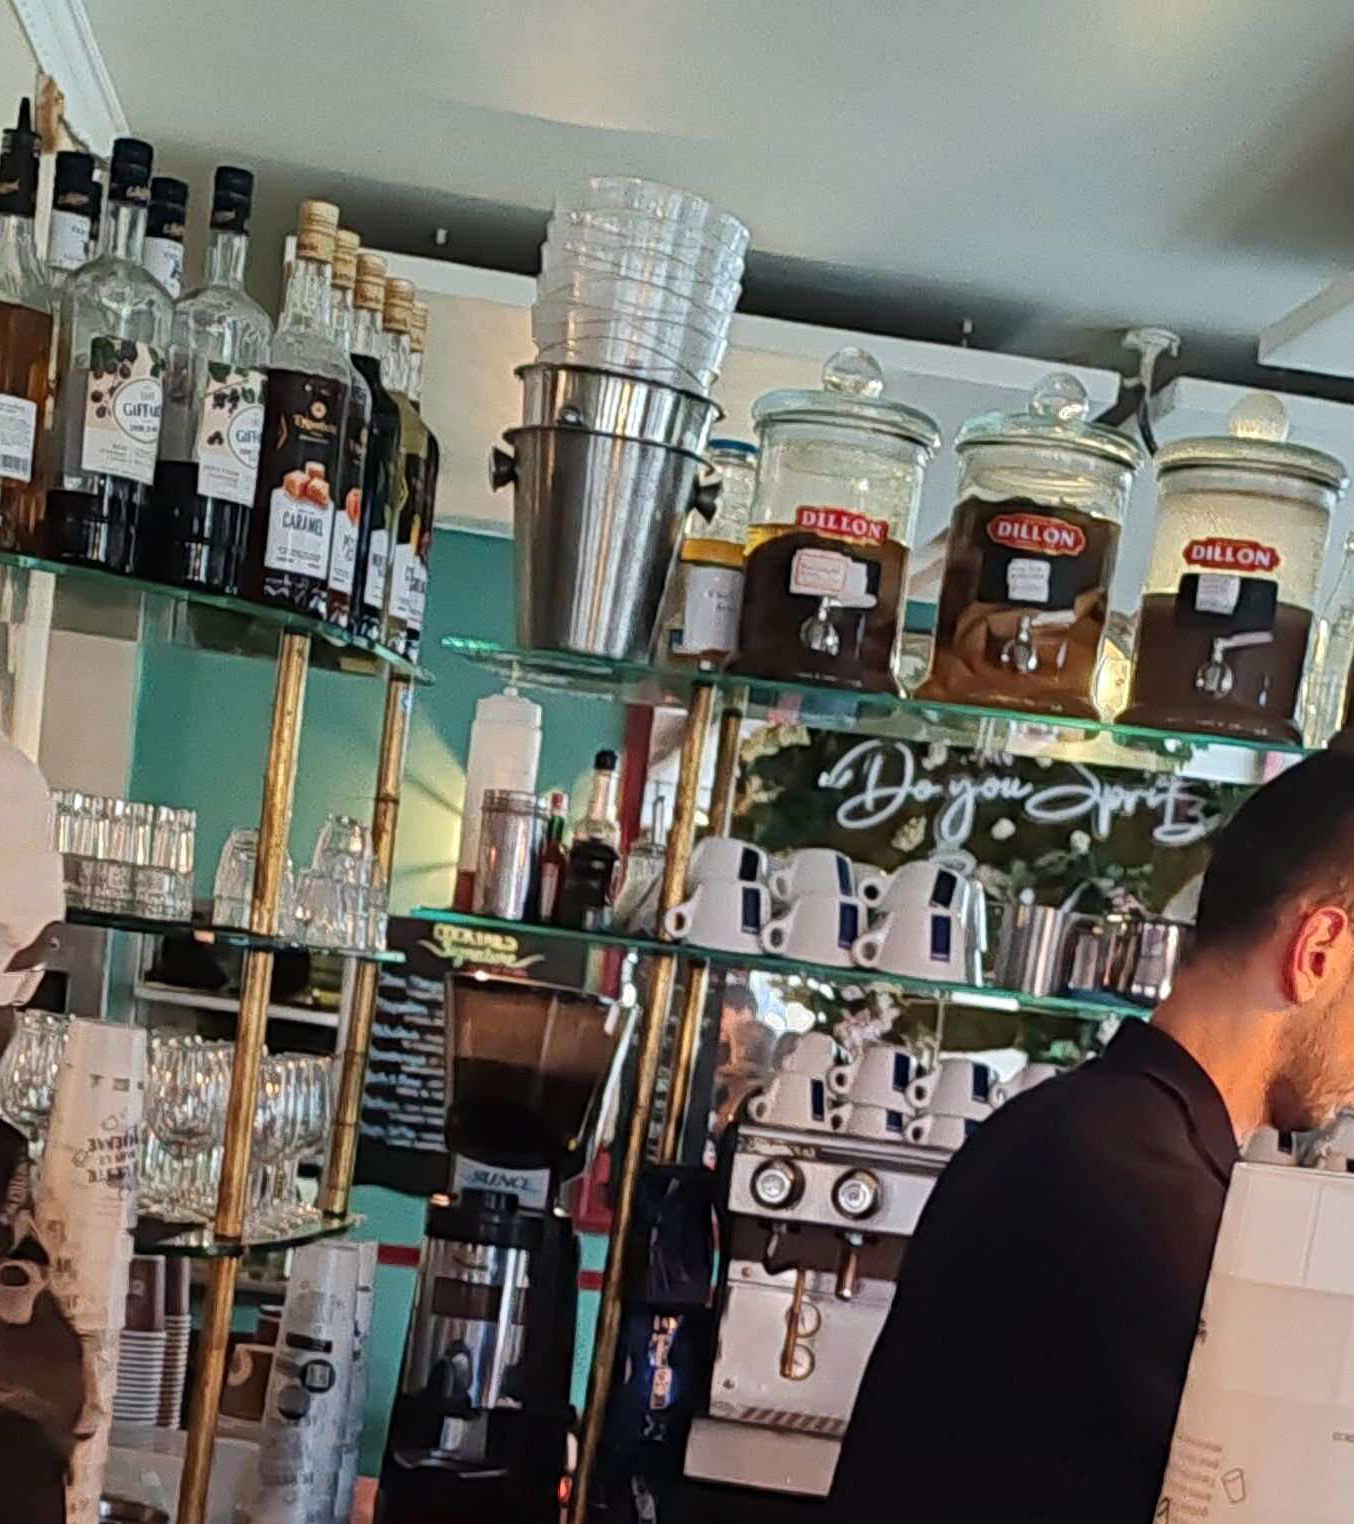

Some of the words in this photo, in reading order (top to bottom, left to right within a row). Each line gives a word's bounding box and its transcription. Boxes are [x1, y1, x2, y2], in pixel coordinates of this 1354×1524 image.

[282, 511, 324, 537] CARAMEL
[800, 511, 883, 540] DILLON
[997, 522, 1076, 547] DILLON
[1190, 544, 1271, 568] DILLON
[939, 776, 1033, 843] you
